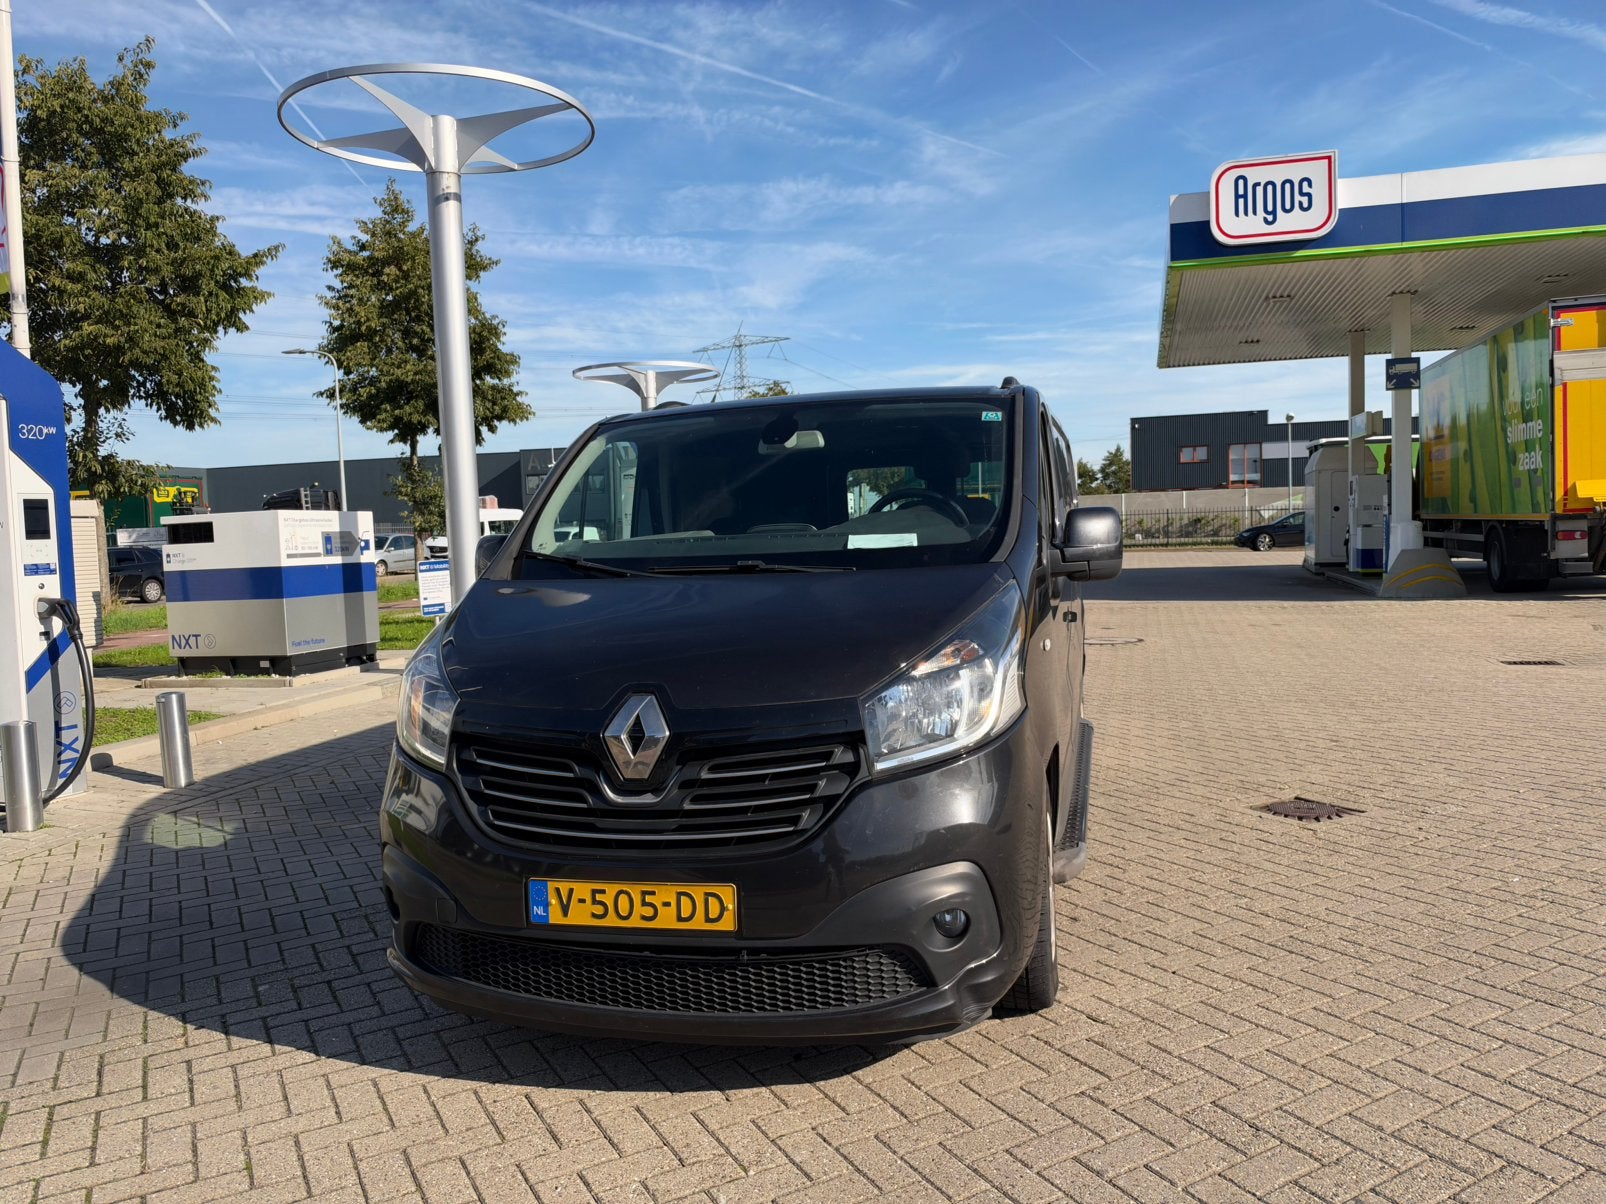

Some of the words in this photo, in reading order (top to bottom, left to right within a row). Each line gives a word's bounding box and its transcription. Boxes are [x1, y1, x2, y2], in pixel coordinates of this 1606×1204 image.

[1234, 174, 1313, 226] Argos
[1524, 387, 1543, 410] een
[1507, 418, 1543, 444] slimme
[1518, 444, 1543, 471] zaak
[171, 633, 202, 650] NXT
[54, 720, 81, 780] NXT
[533, 905, 547, 916] NL
[554, 886, 726, 924] V-505-DD
